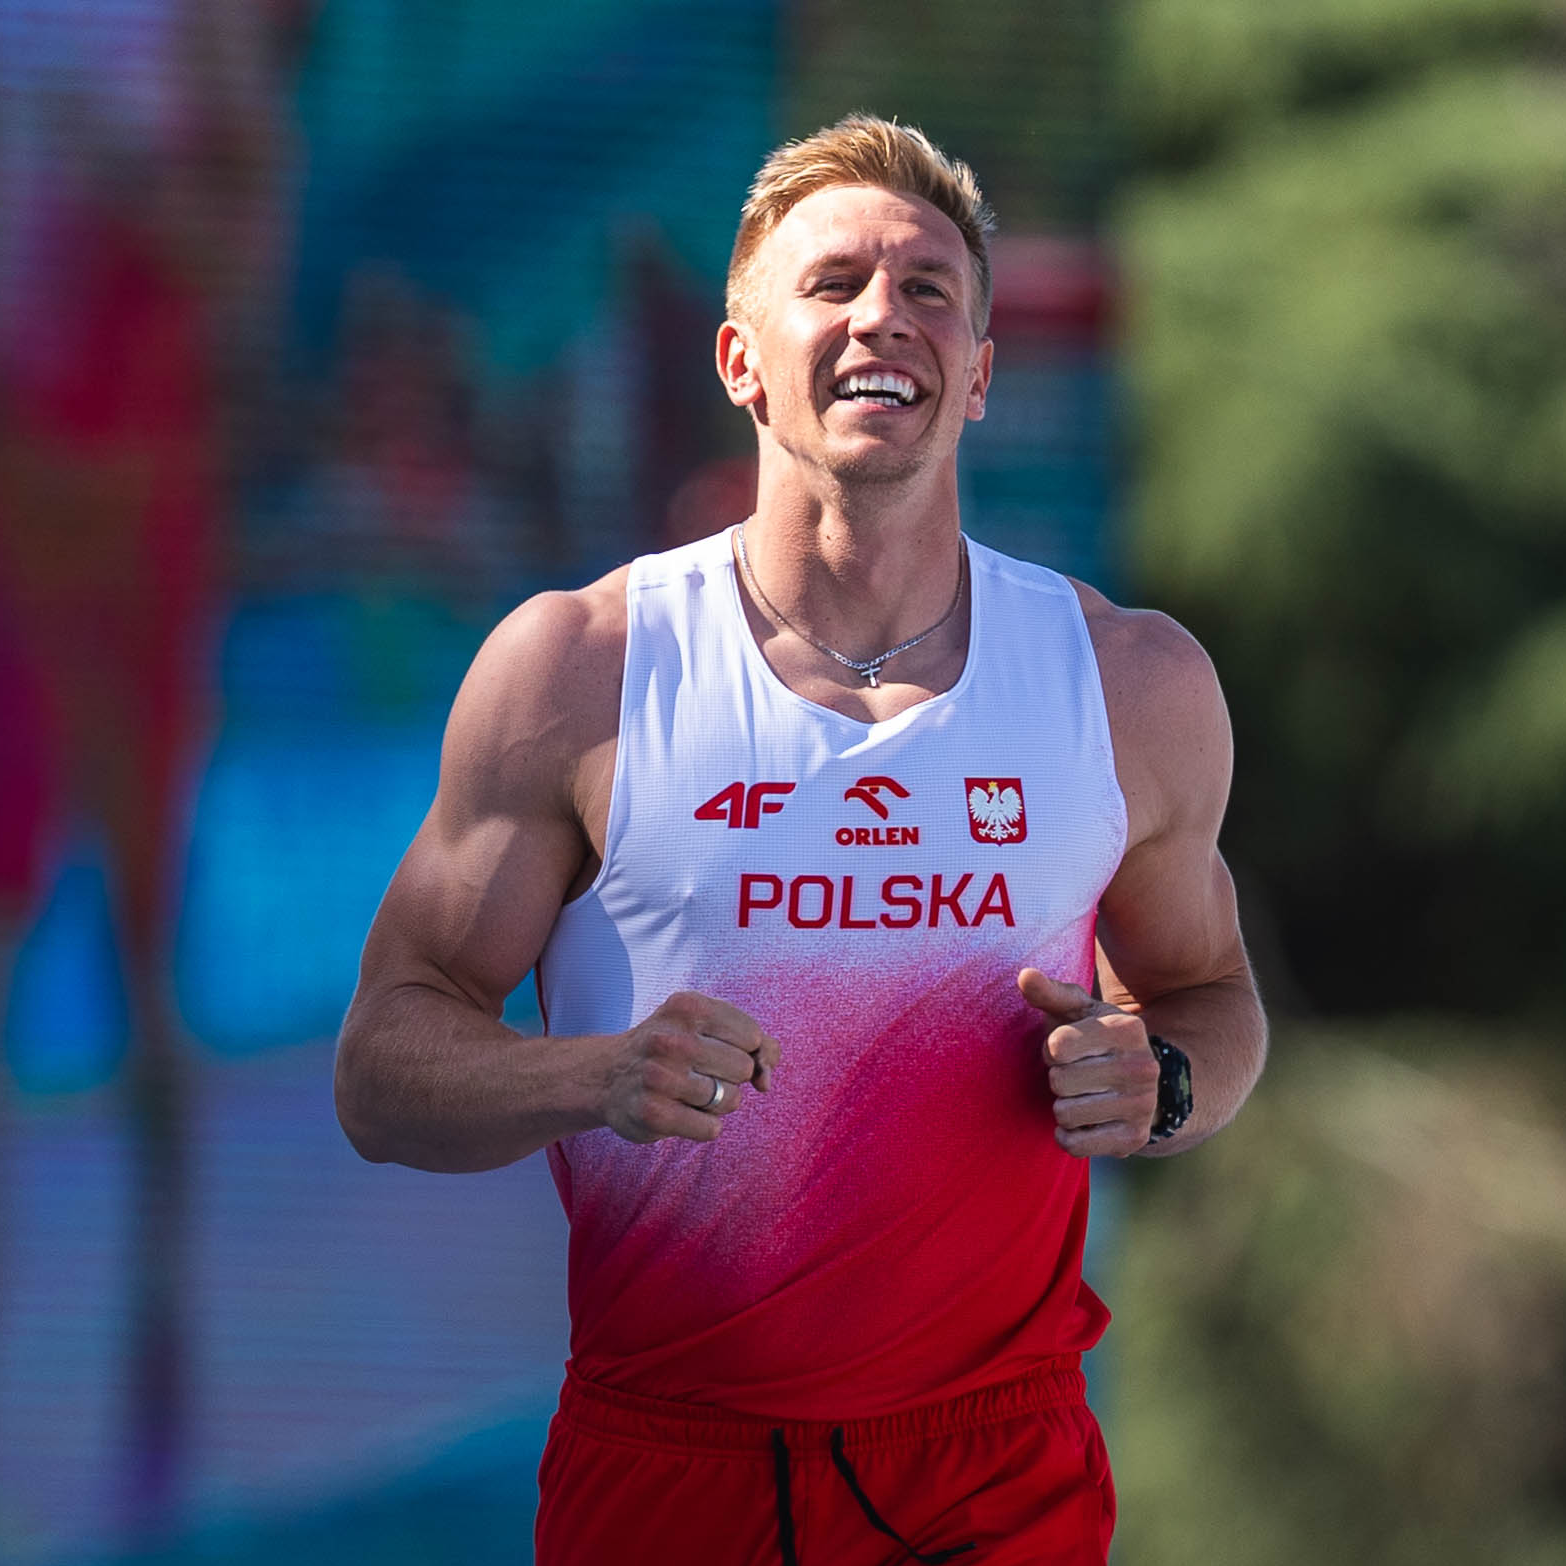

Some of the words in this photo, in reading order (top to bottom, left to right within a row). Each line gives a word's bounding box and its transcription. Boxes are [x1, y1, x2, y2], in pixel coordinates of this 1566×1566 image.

[694, 781, 796, 829] 4F
[835, 826, 919, 846] ORLEN
[738, 872, 1016, 930] POLSKA
